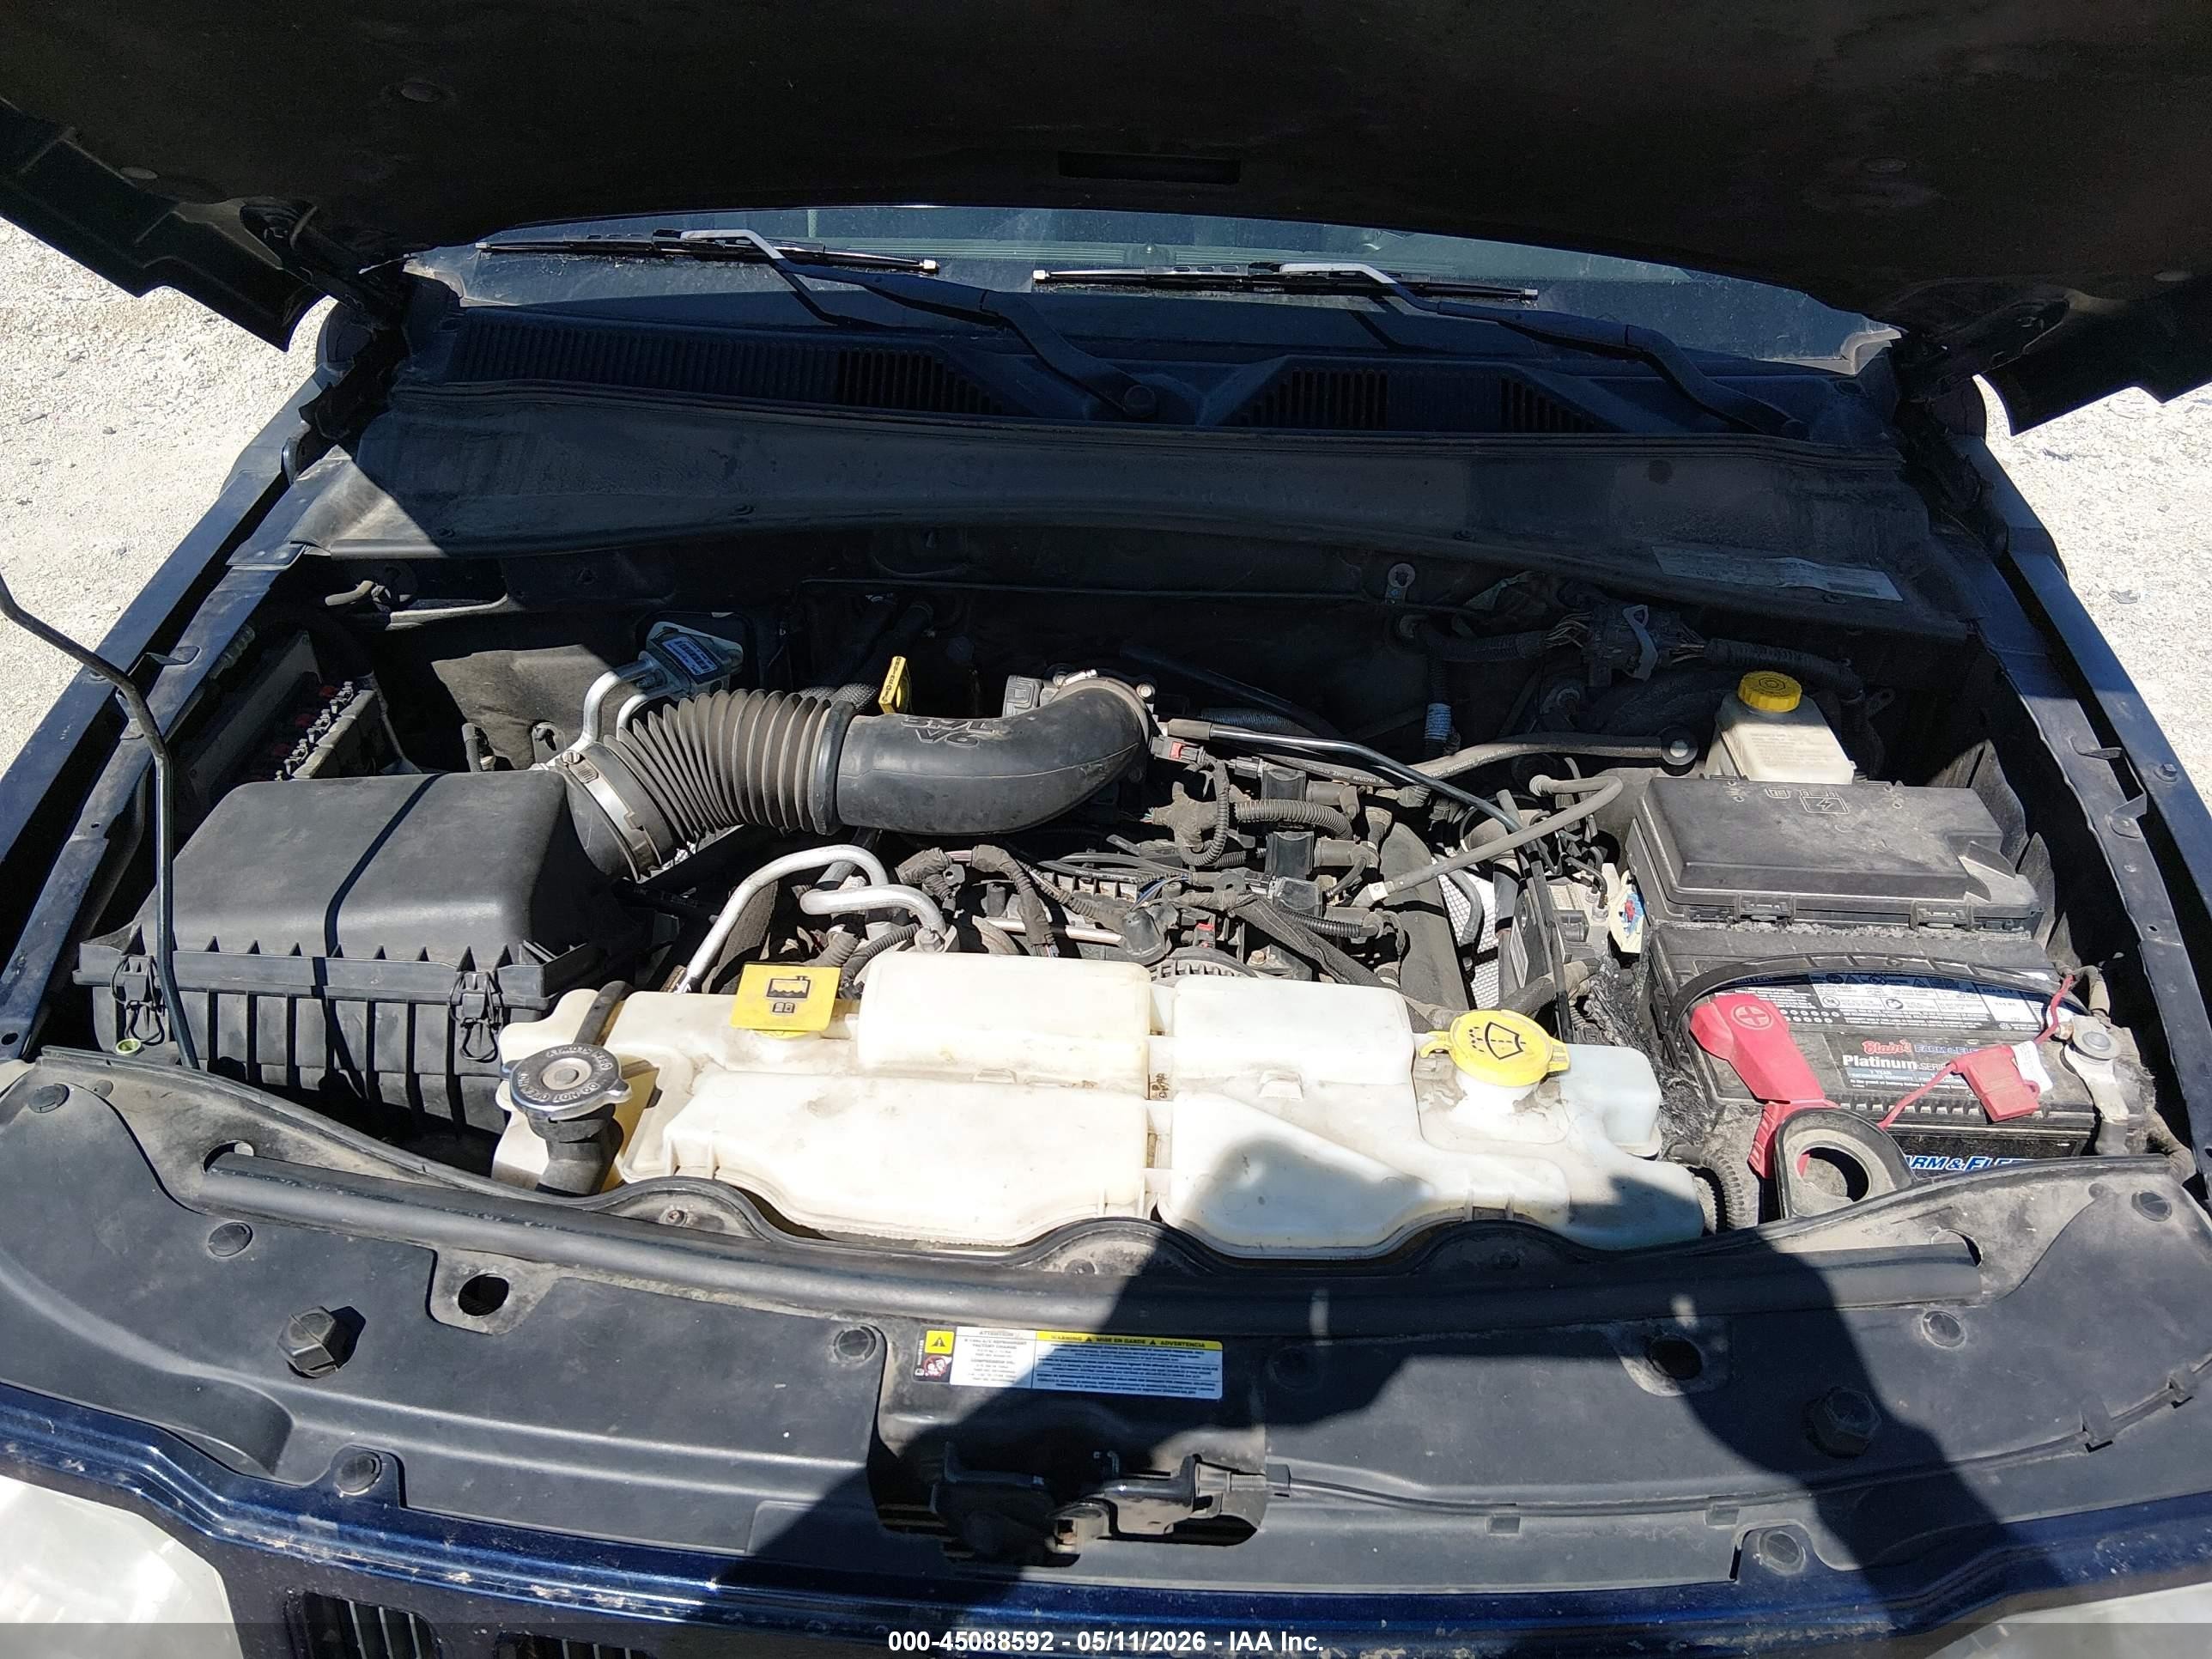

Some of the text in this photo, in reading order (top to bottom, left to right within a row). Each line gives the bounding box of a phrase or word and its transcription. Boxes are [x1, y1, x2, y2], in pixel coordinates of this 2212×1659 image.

[915, 728, 980, 748] V6
[1862, 1038, 1911, 1055] Blain's
[1842, 1054, 1947, 1071] Platinum SERIE
[582, 1082, 600, 1095] DO
[553, 1093, 580, 1103] NOT
[1946, 1157, 1965, 1171] &
